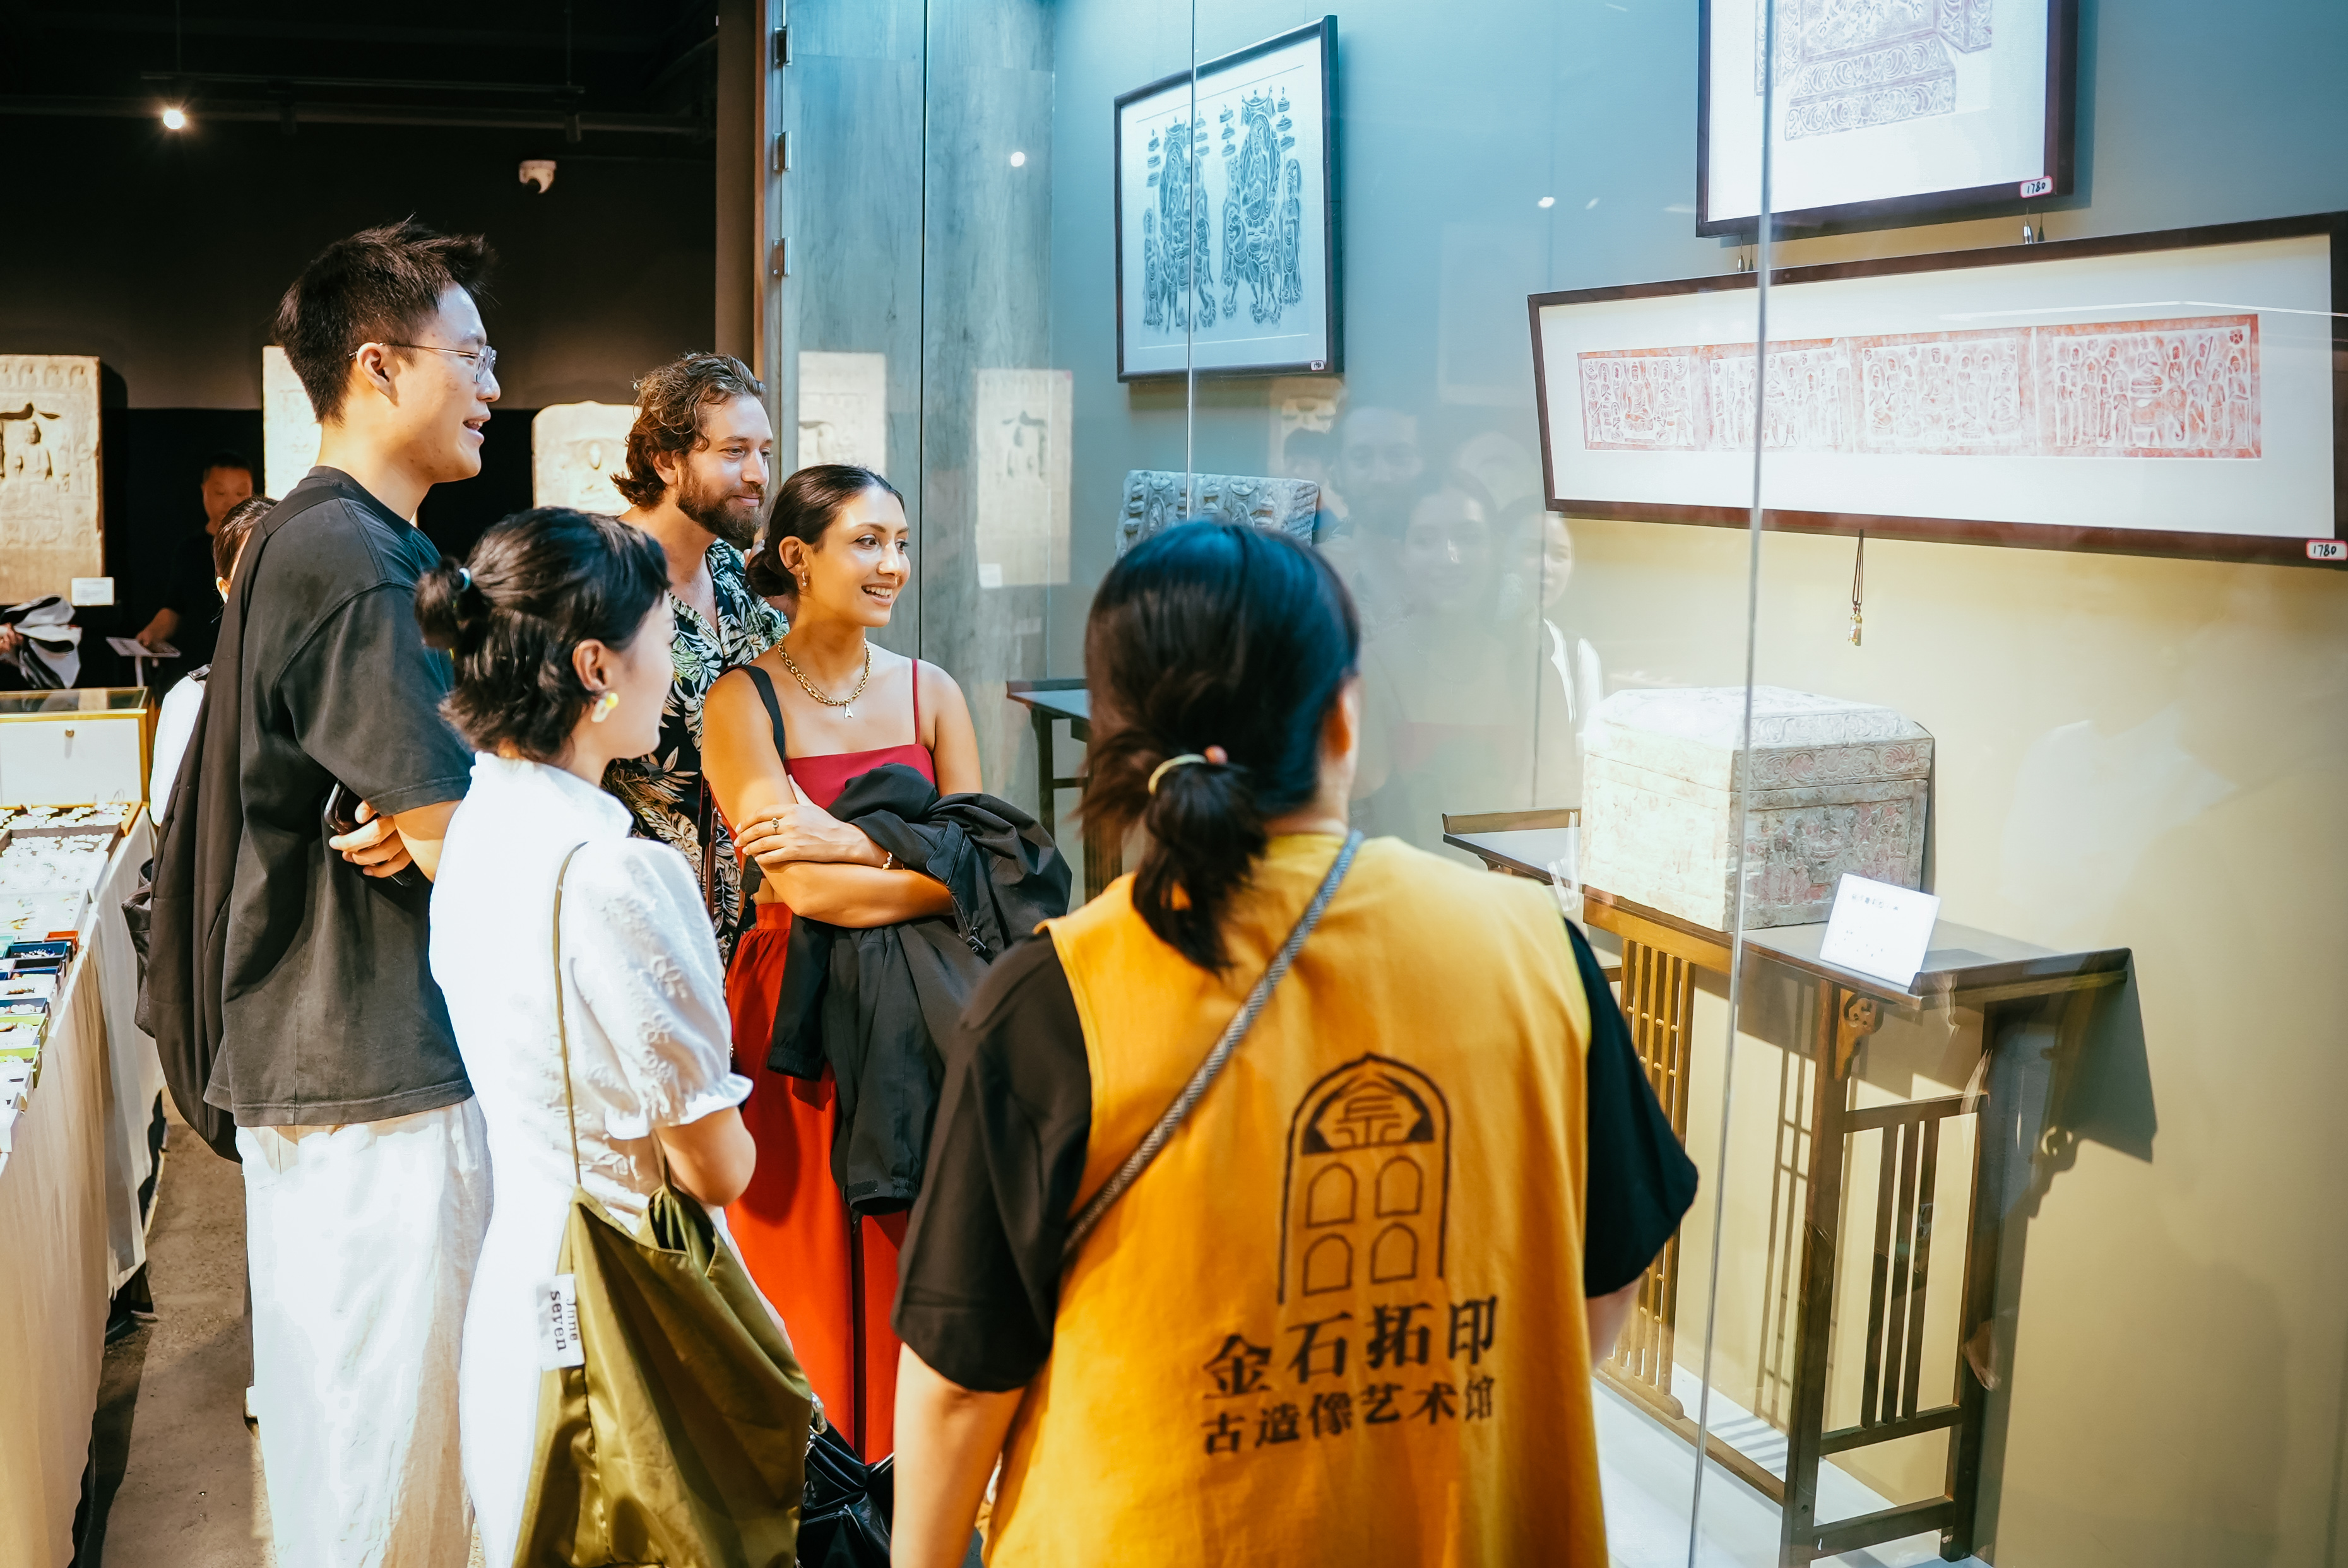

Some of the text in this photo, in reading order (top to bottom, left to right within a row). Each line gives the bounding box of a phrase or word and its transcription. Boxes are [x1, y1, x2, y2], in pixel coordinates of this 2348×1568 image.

[2027, 180, 2046, 194] 1780
[2313, 544, 2337, 557] 1780
[550, 1290, 567, 1352] seven
[1202, 1294, 1497, 1400] 金石拓印
[1201, 1374, 1495, 1456] 古造像艺术馆
